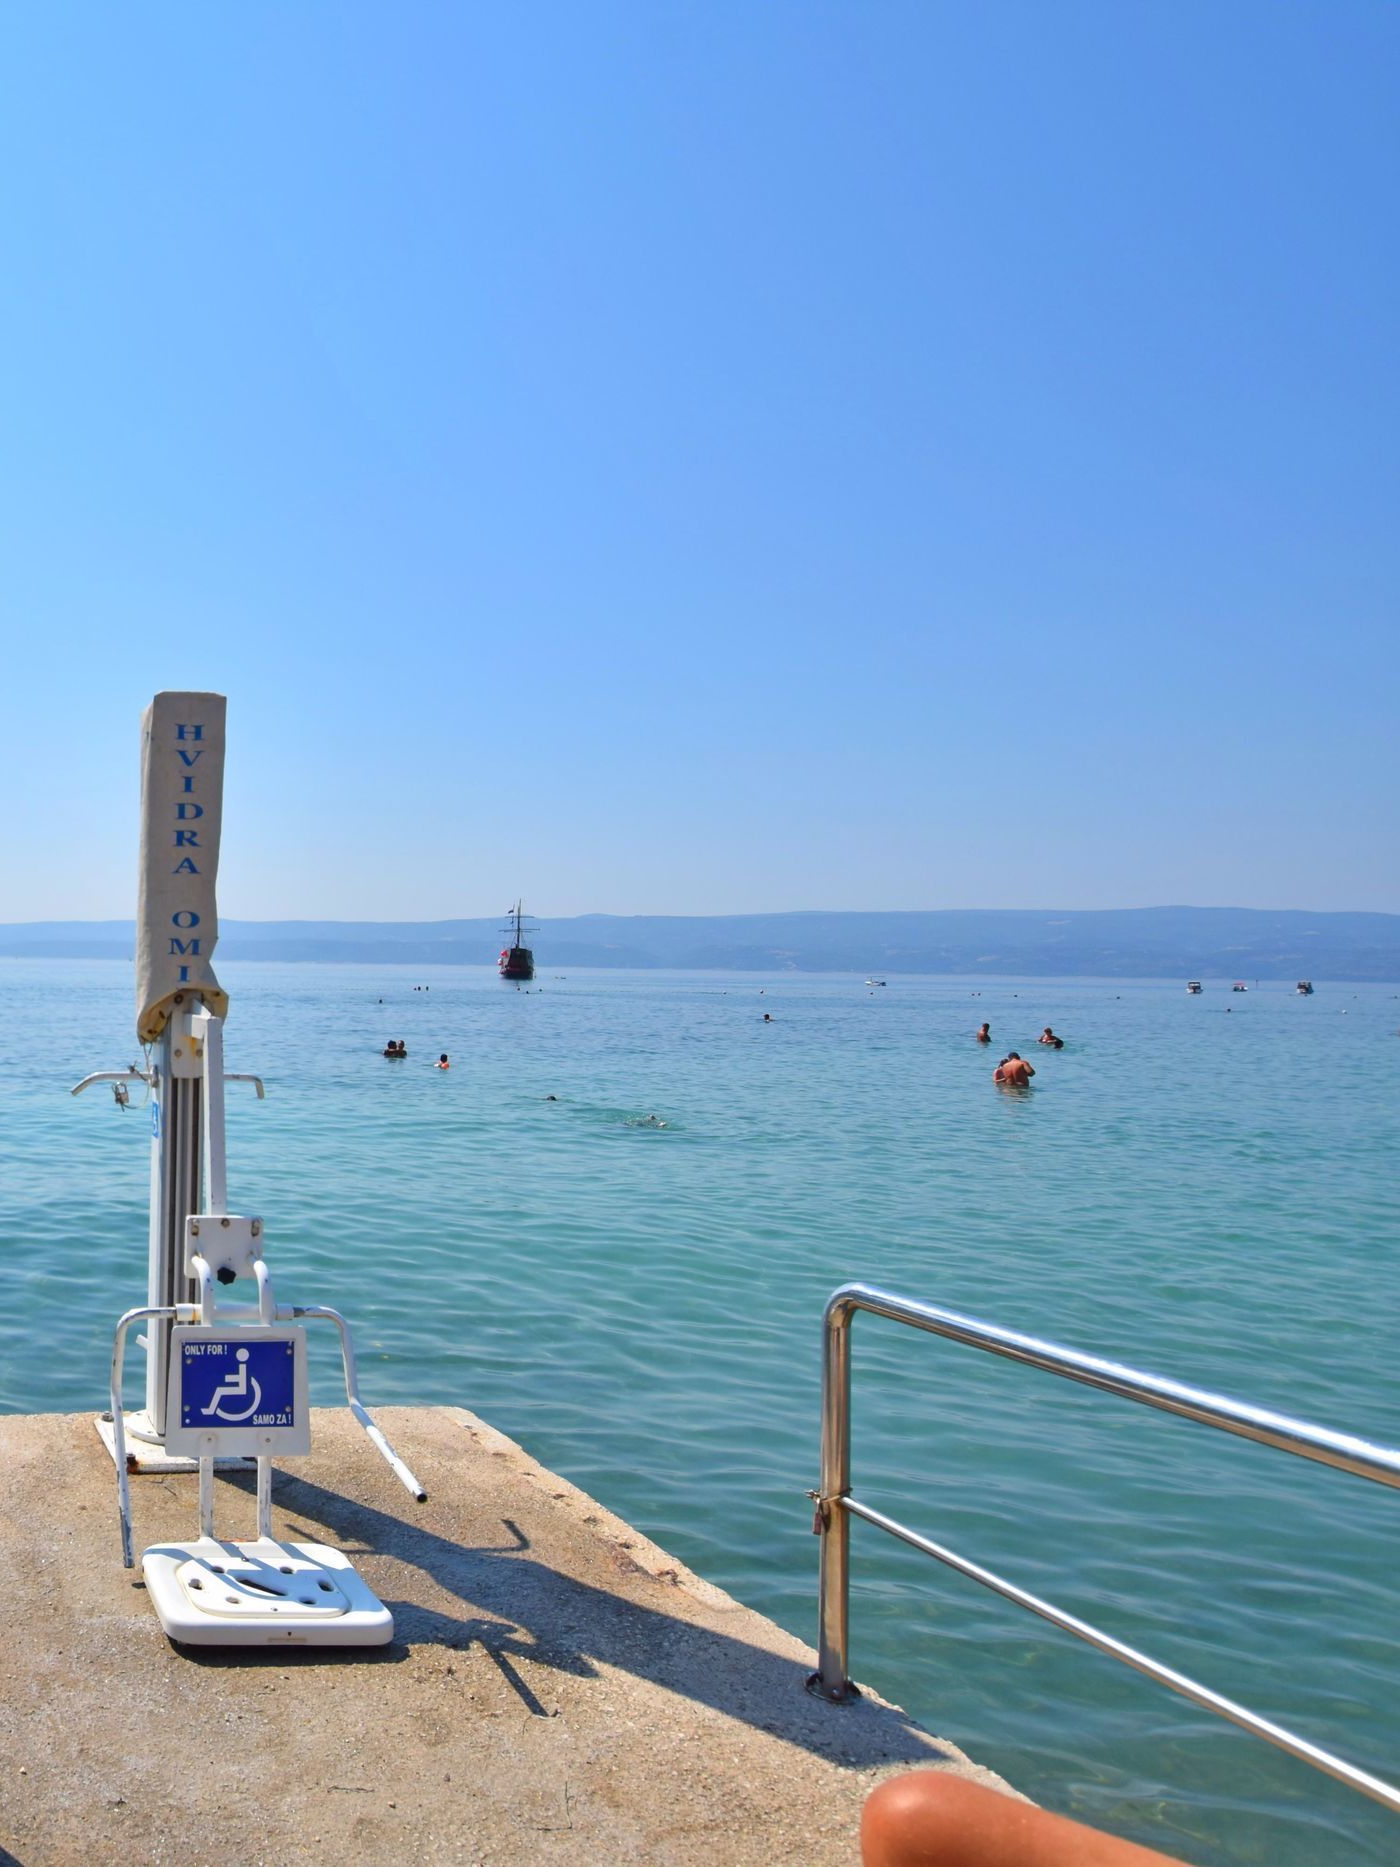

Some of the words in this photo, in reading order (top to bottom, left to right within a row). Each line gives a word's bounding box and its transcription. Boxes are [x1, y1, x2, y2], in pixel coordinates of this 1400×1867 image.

[171, 724, 205, 874] HVIDRA
[184, 1344, 206, 1356] ONLY
[252, 1414, 275, 1425] SAMO
